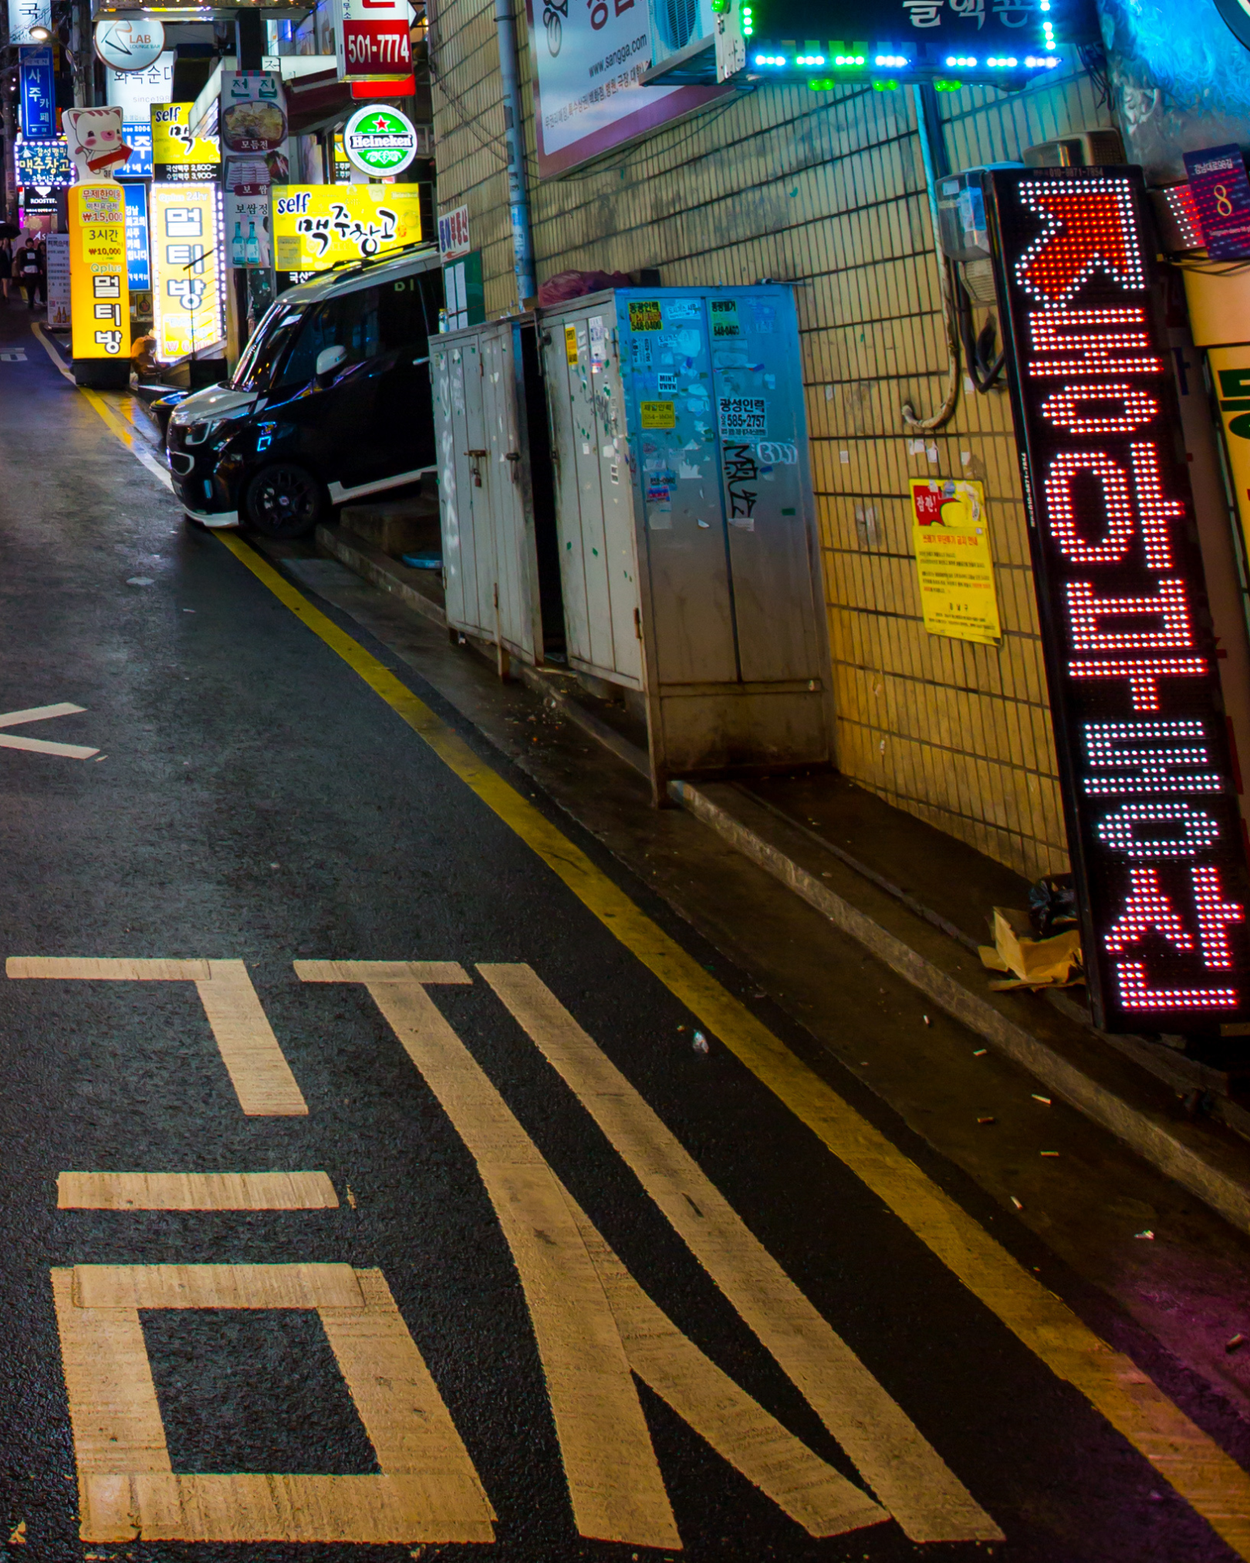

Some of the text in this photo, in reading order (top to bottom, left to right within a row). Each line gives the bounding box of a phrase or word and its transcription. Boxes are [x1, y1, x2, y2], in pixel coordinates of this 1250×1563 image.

[129, 34, 152, 44] LAB
[348, 34, 410, 64] 501-7774
[155, 106, 182, 123] self
[351, 135, 413, 148] Heineken
[18, 157, 71, 175] 맥주창고
[82, 190, 122, 200] 무제한이용
[186, 191, 209, 202] 24hr
[1213, 184, 1232, 217] 8
[277, 192, 397, 257] self 맥주창고
[88, 229, 118, 243] 3시간
[164, 207, 207, 311] 멀티방
[93, 275, 123, 354] 멀티방
[719, 398, 766, 414] 광성인력
[726, 414, 766, 428] 585-2757
